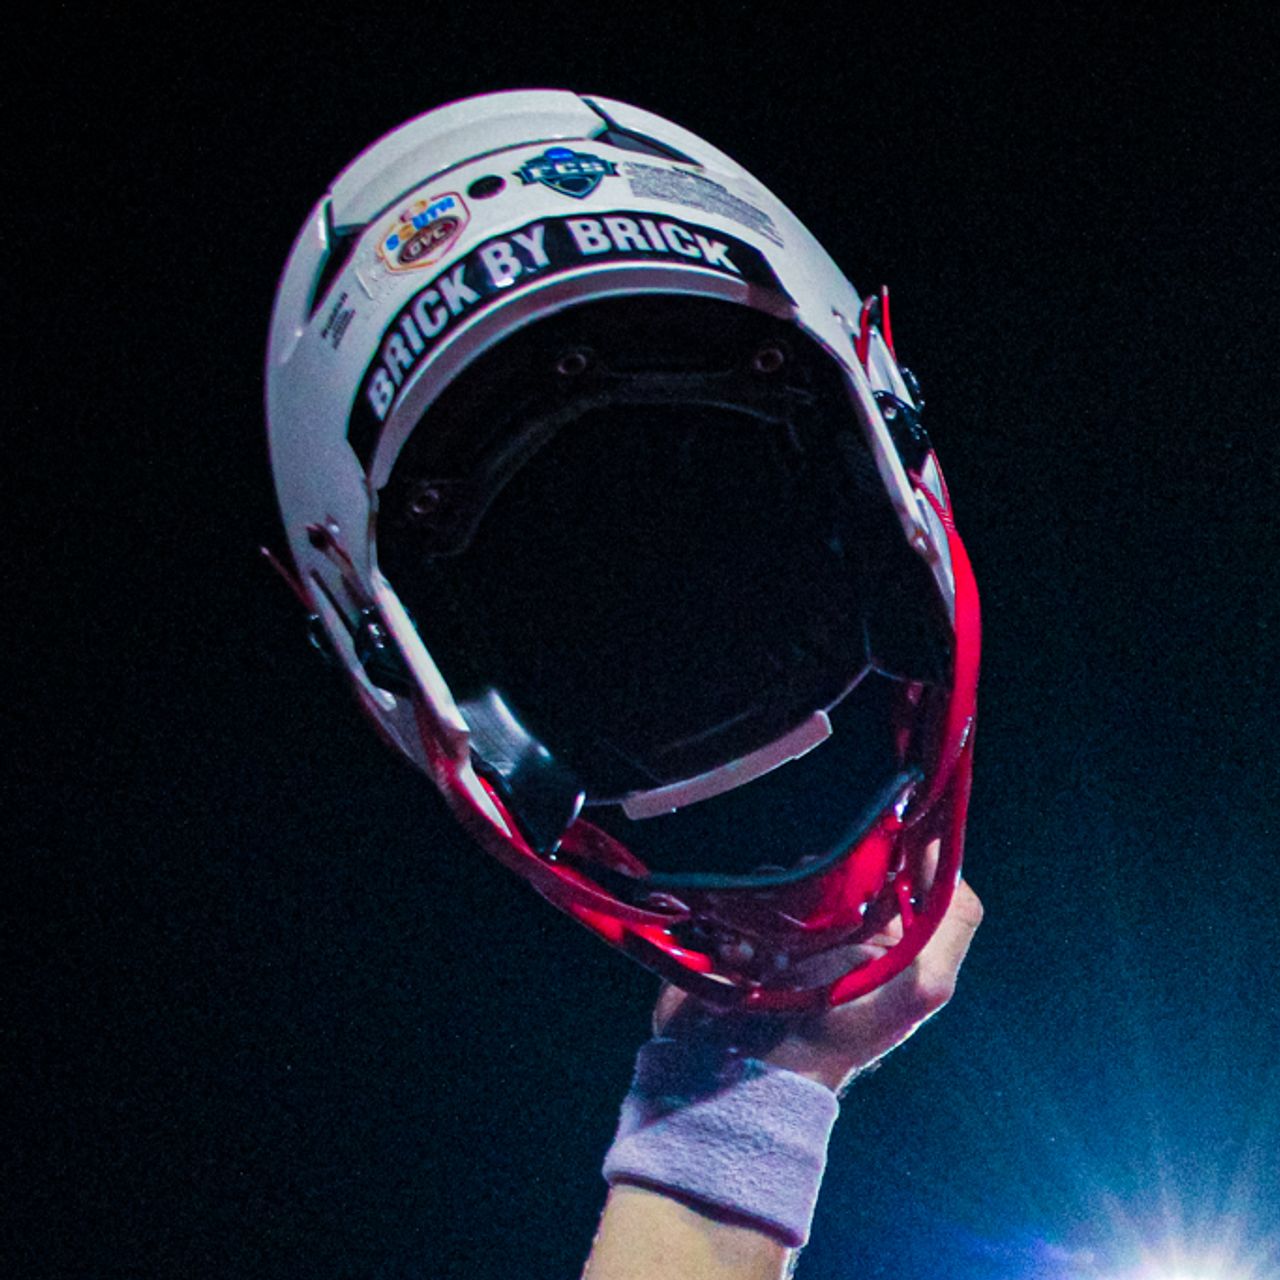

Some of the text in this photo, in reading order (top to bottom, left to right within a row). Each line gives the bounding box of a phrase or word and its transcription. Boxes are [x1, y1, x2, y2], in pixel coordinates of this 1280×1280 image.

[409, 223, 454, 258] OVC
[367, 263, 481, 421] BRICK
[478, 224, 550, 288] BY
[565, 217, 742, 275] BRICK
